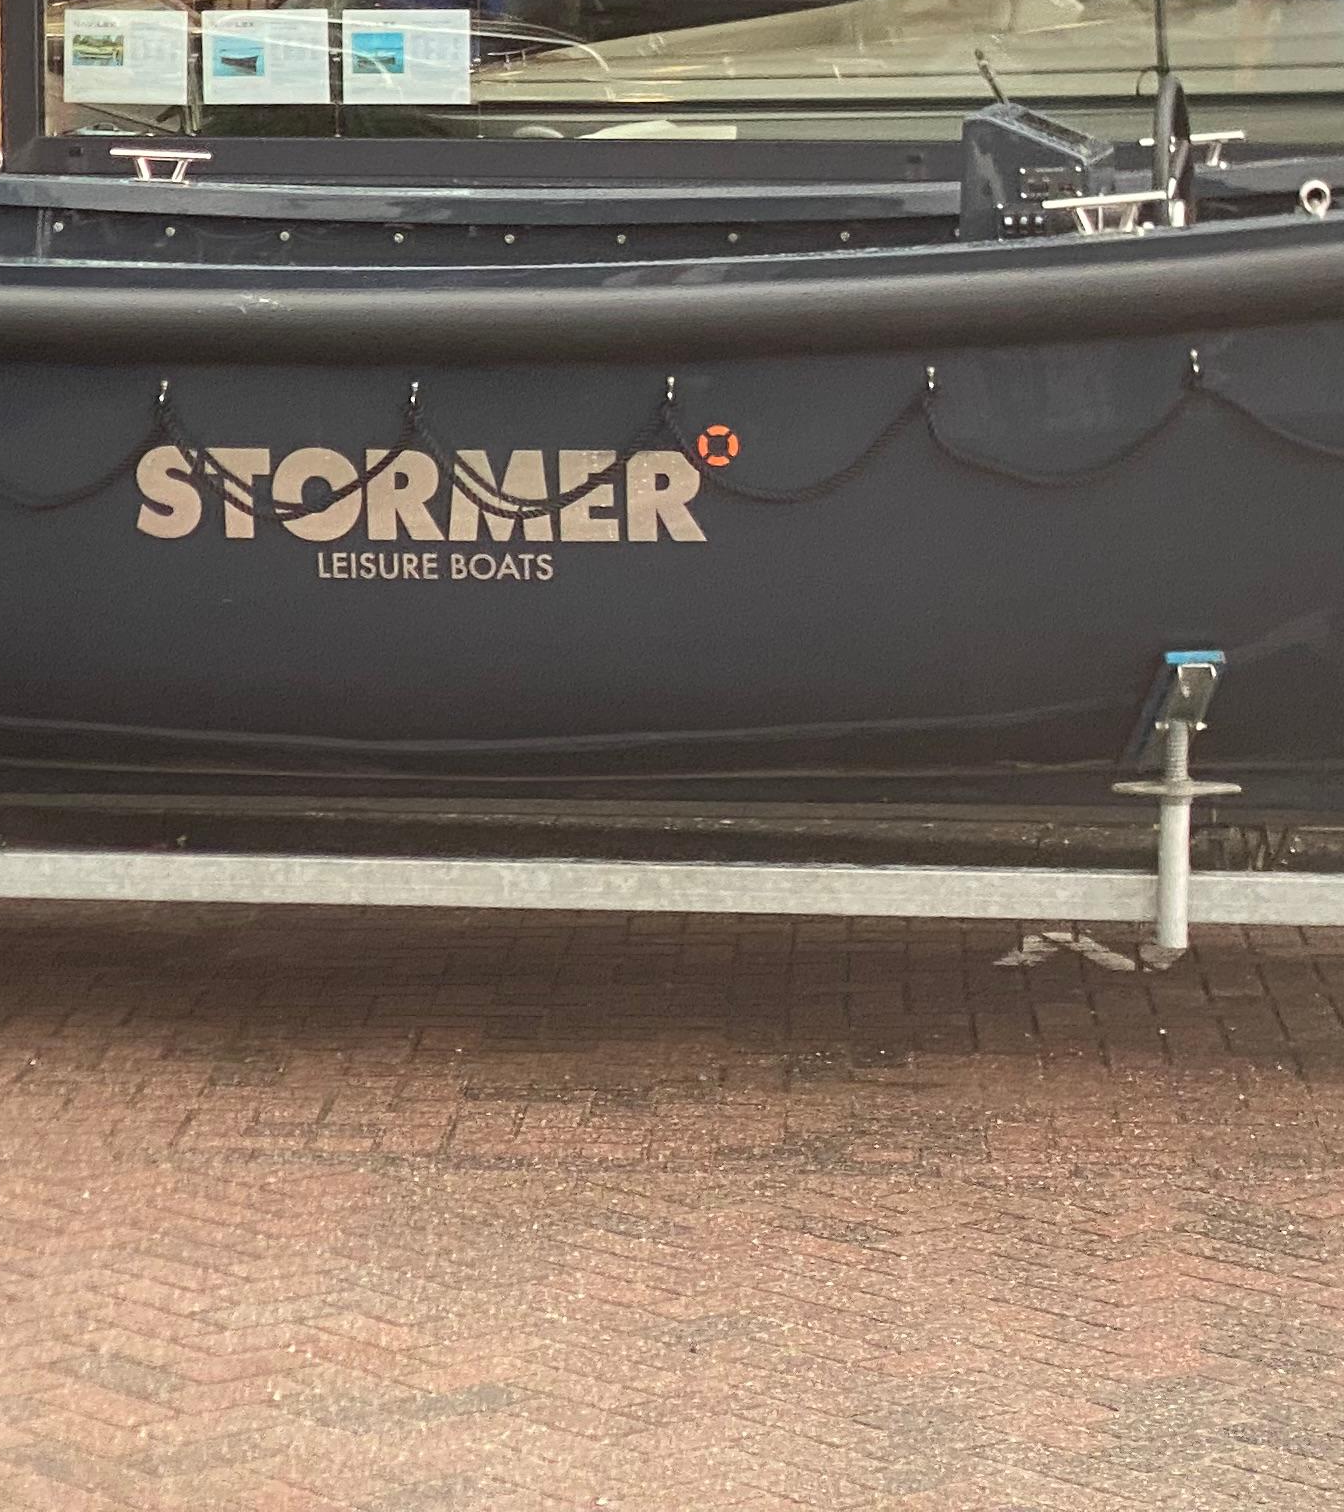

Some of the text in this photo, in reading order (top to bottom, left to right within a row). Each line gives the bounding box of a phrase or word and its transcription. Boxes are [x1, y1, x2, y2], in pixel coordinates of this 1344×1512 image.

[136, 445, 707, 542] STORMER
[317, 552, 554, 581] LEISURE BOATS
